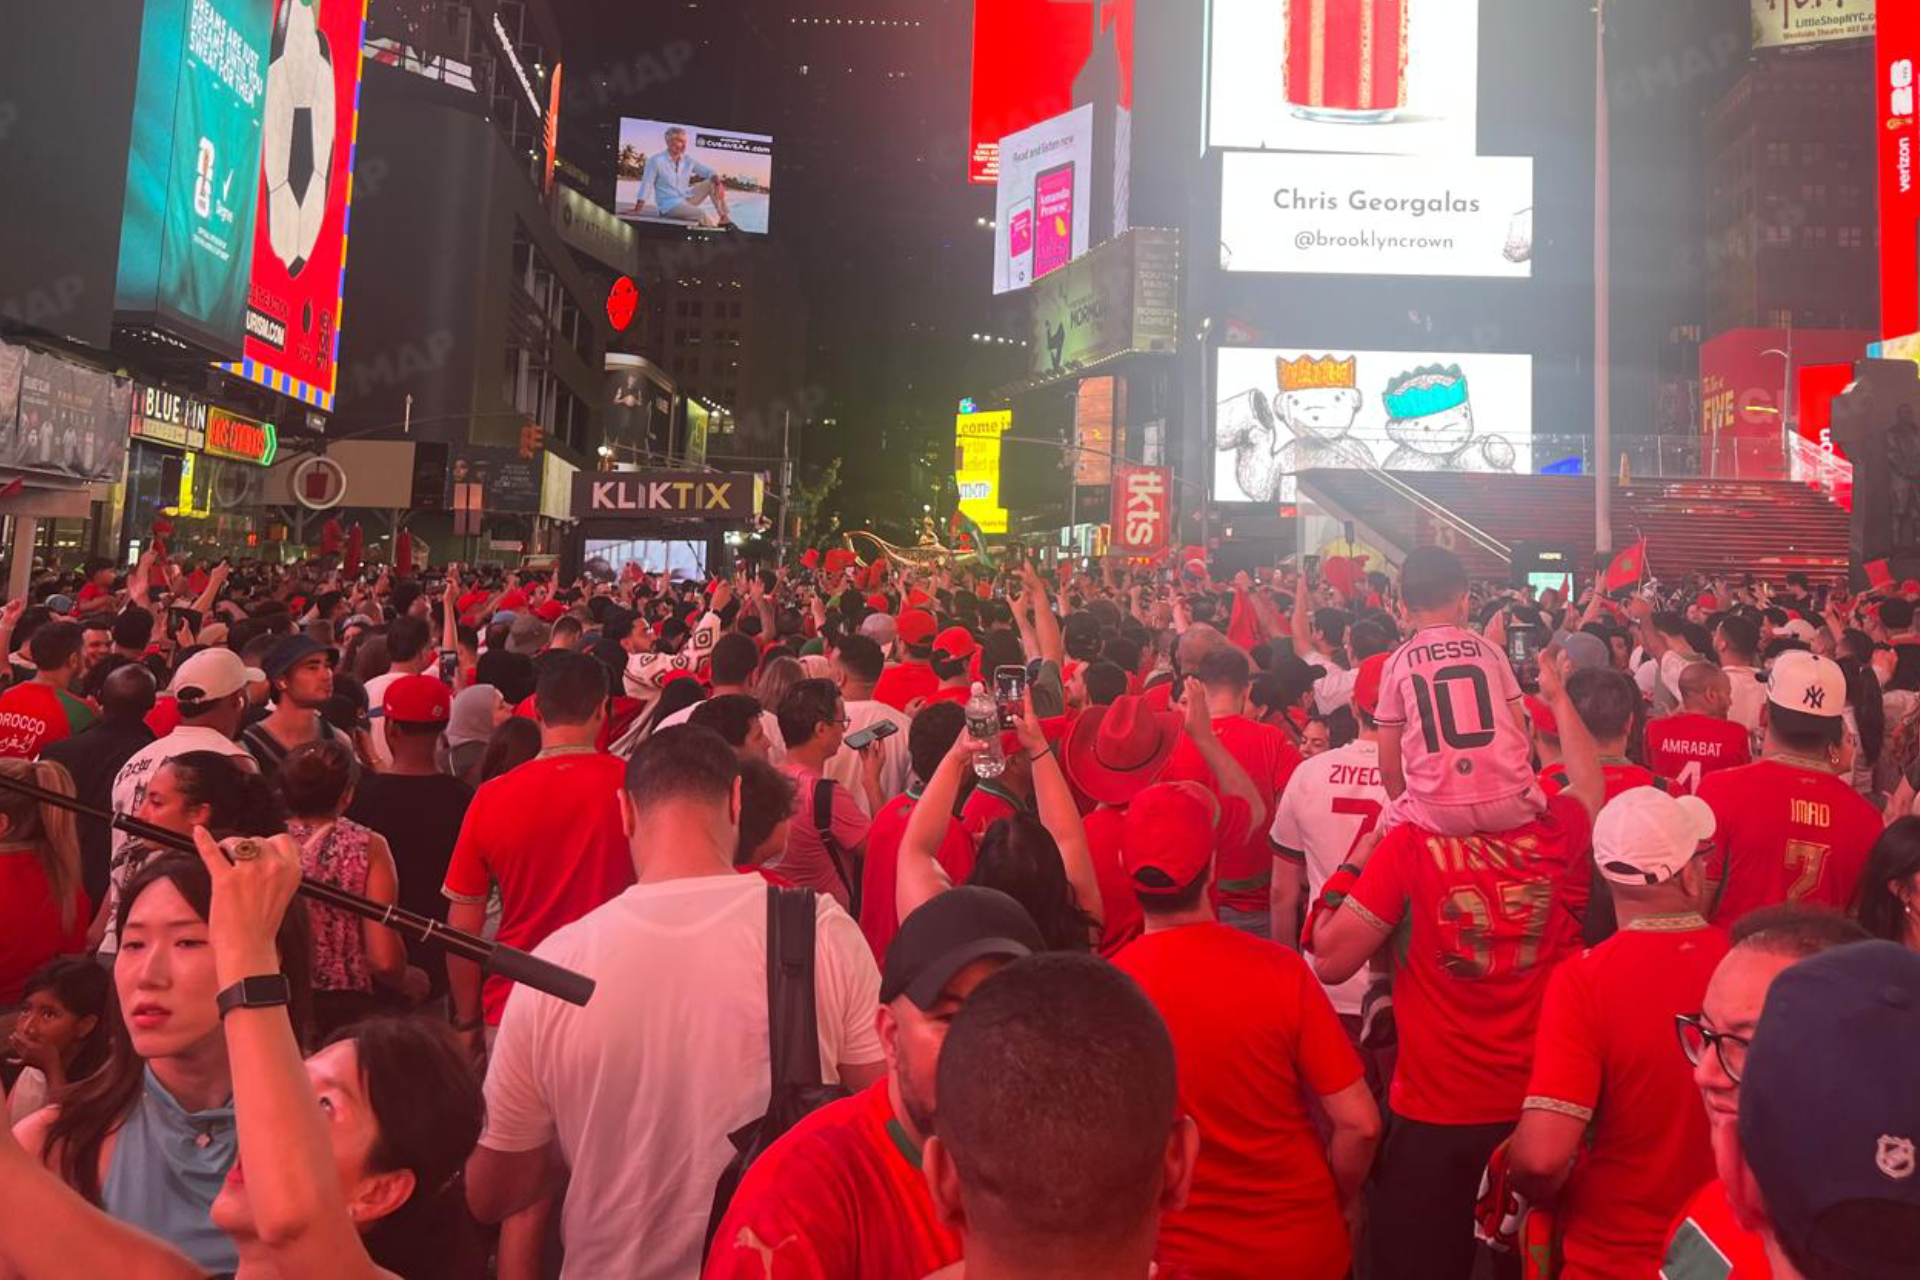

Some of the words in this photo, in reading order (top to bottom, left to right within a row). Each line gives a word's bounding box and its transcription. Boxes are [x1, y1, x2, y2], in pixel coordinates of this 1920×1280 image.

[1896, 137, 1910, 192] verizon
[1273, 188, 1338, 211] Chris
[1348, 189, 1480, 217] Georgalas
[1294, 229, 1454, 250] @brooklyncrown
[146, 387, 181, 423] BLUE
[592, 481, 731, 510] KLIKTIX
[1126, 471, 1164, 545] tkts
[1407, 640, 1482, 668] MESSI
[1411, 664, 1495, 755] 10
[1661, 738, 1723, 758] AMRABAT
[1790, 798, 1831, 828] IMAD
